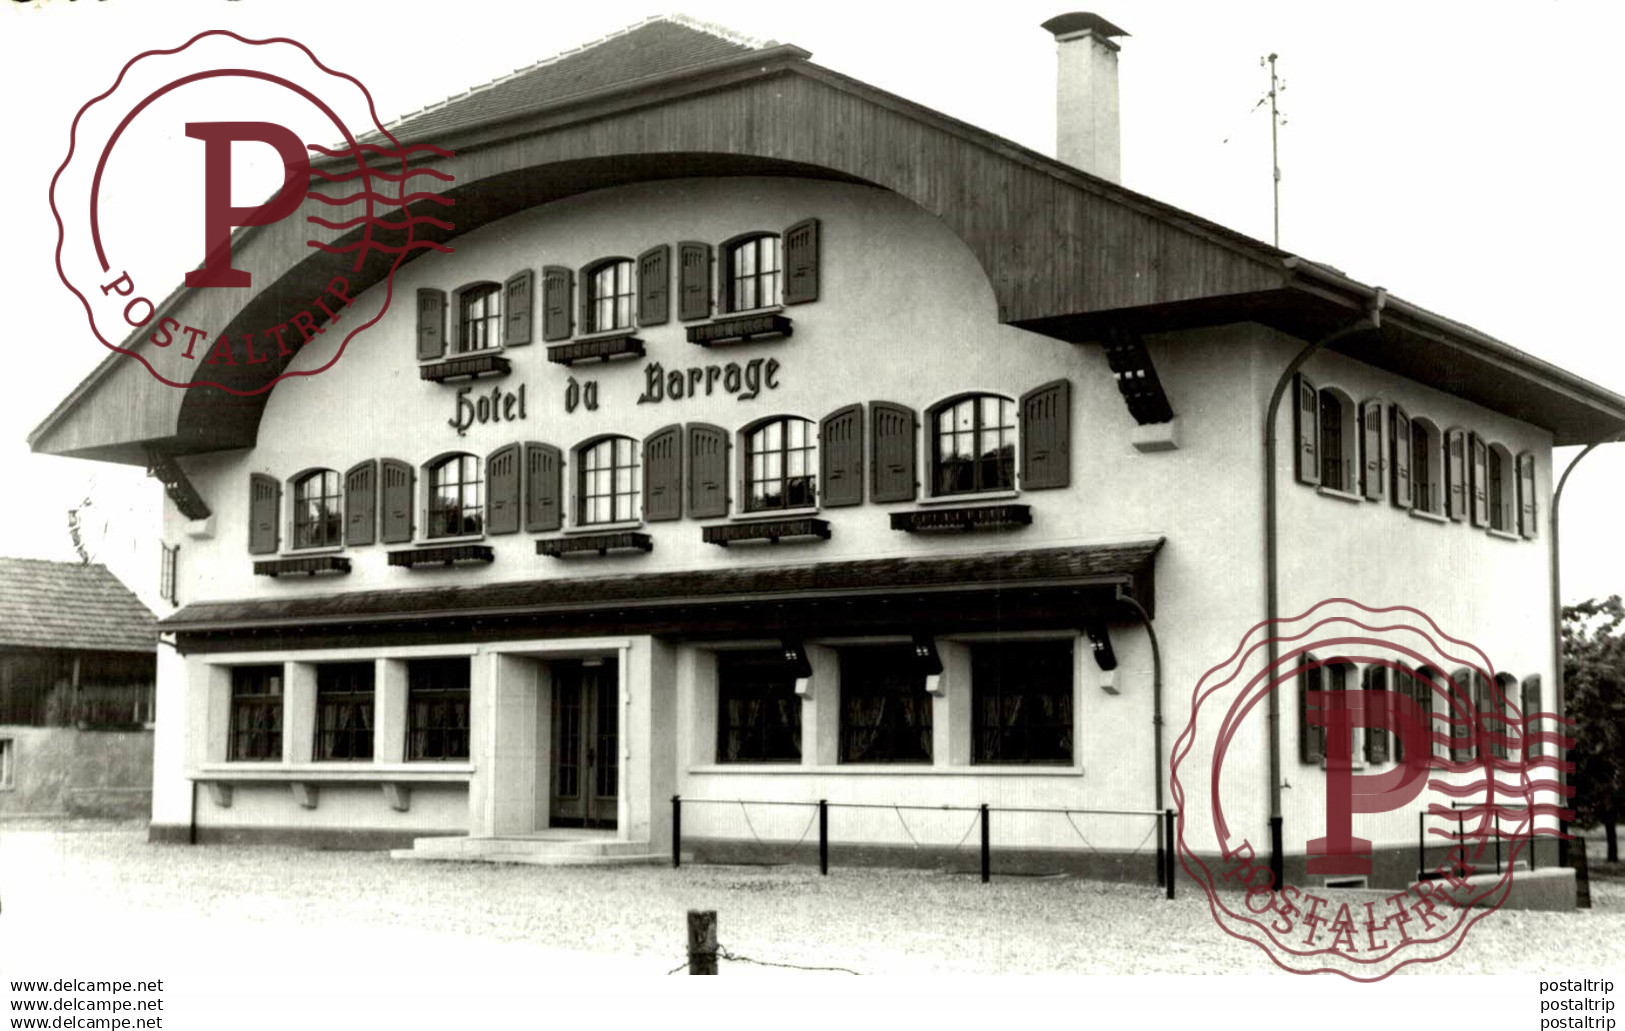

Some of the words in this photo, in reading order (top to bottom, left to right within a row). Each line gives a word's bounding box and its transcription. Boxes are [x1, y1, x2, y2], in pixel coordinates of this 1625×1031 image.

[448, 383, 527, 437] Hotel
[564, 375, 600, 414] du
[637, 356, 781, 405] Barrage
